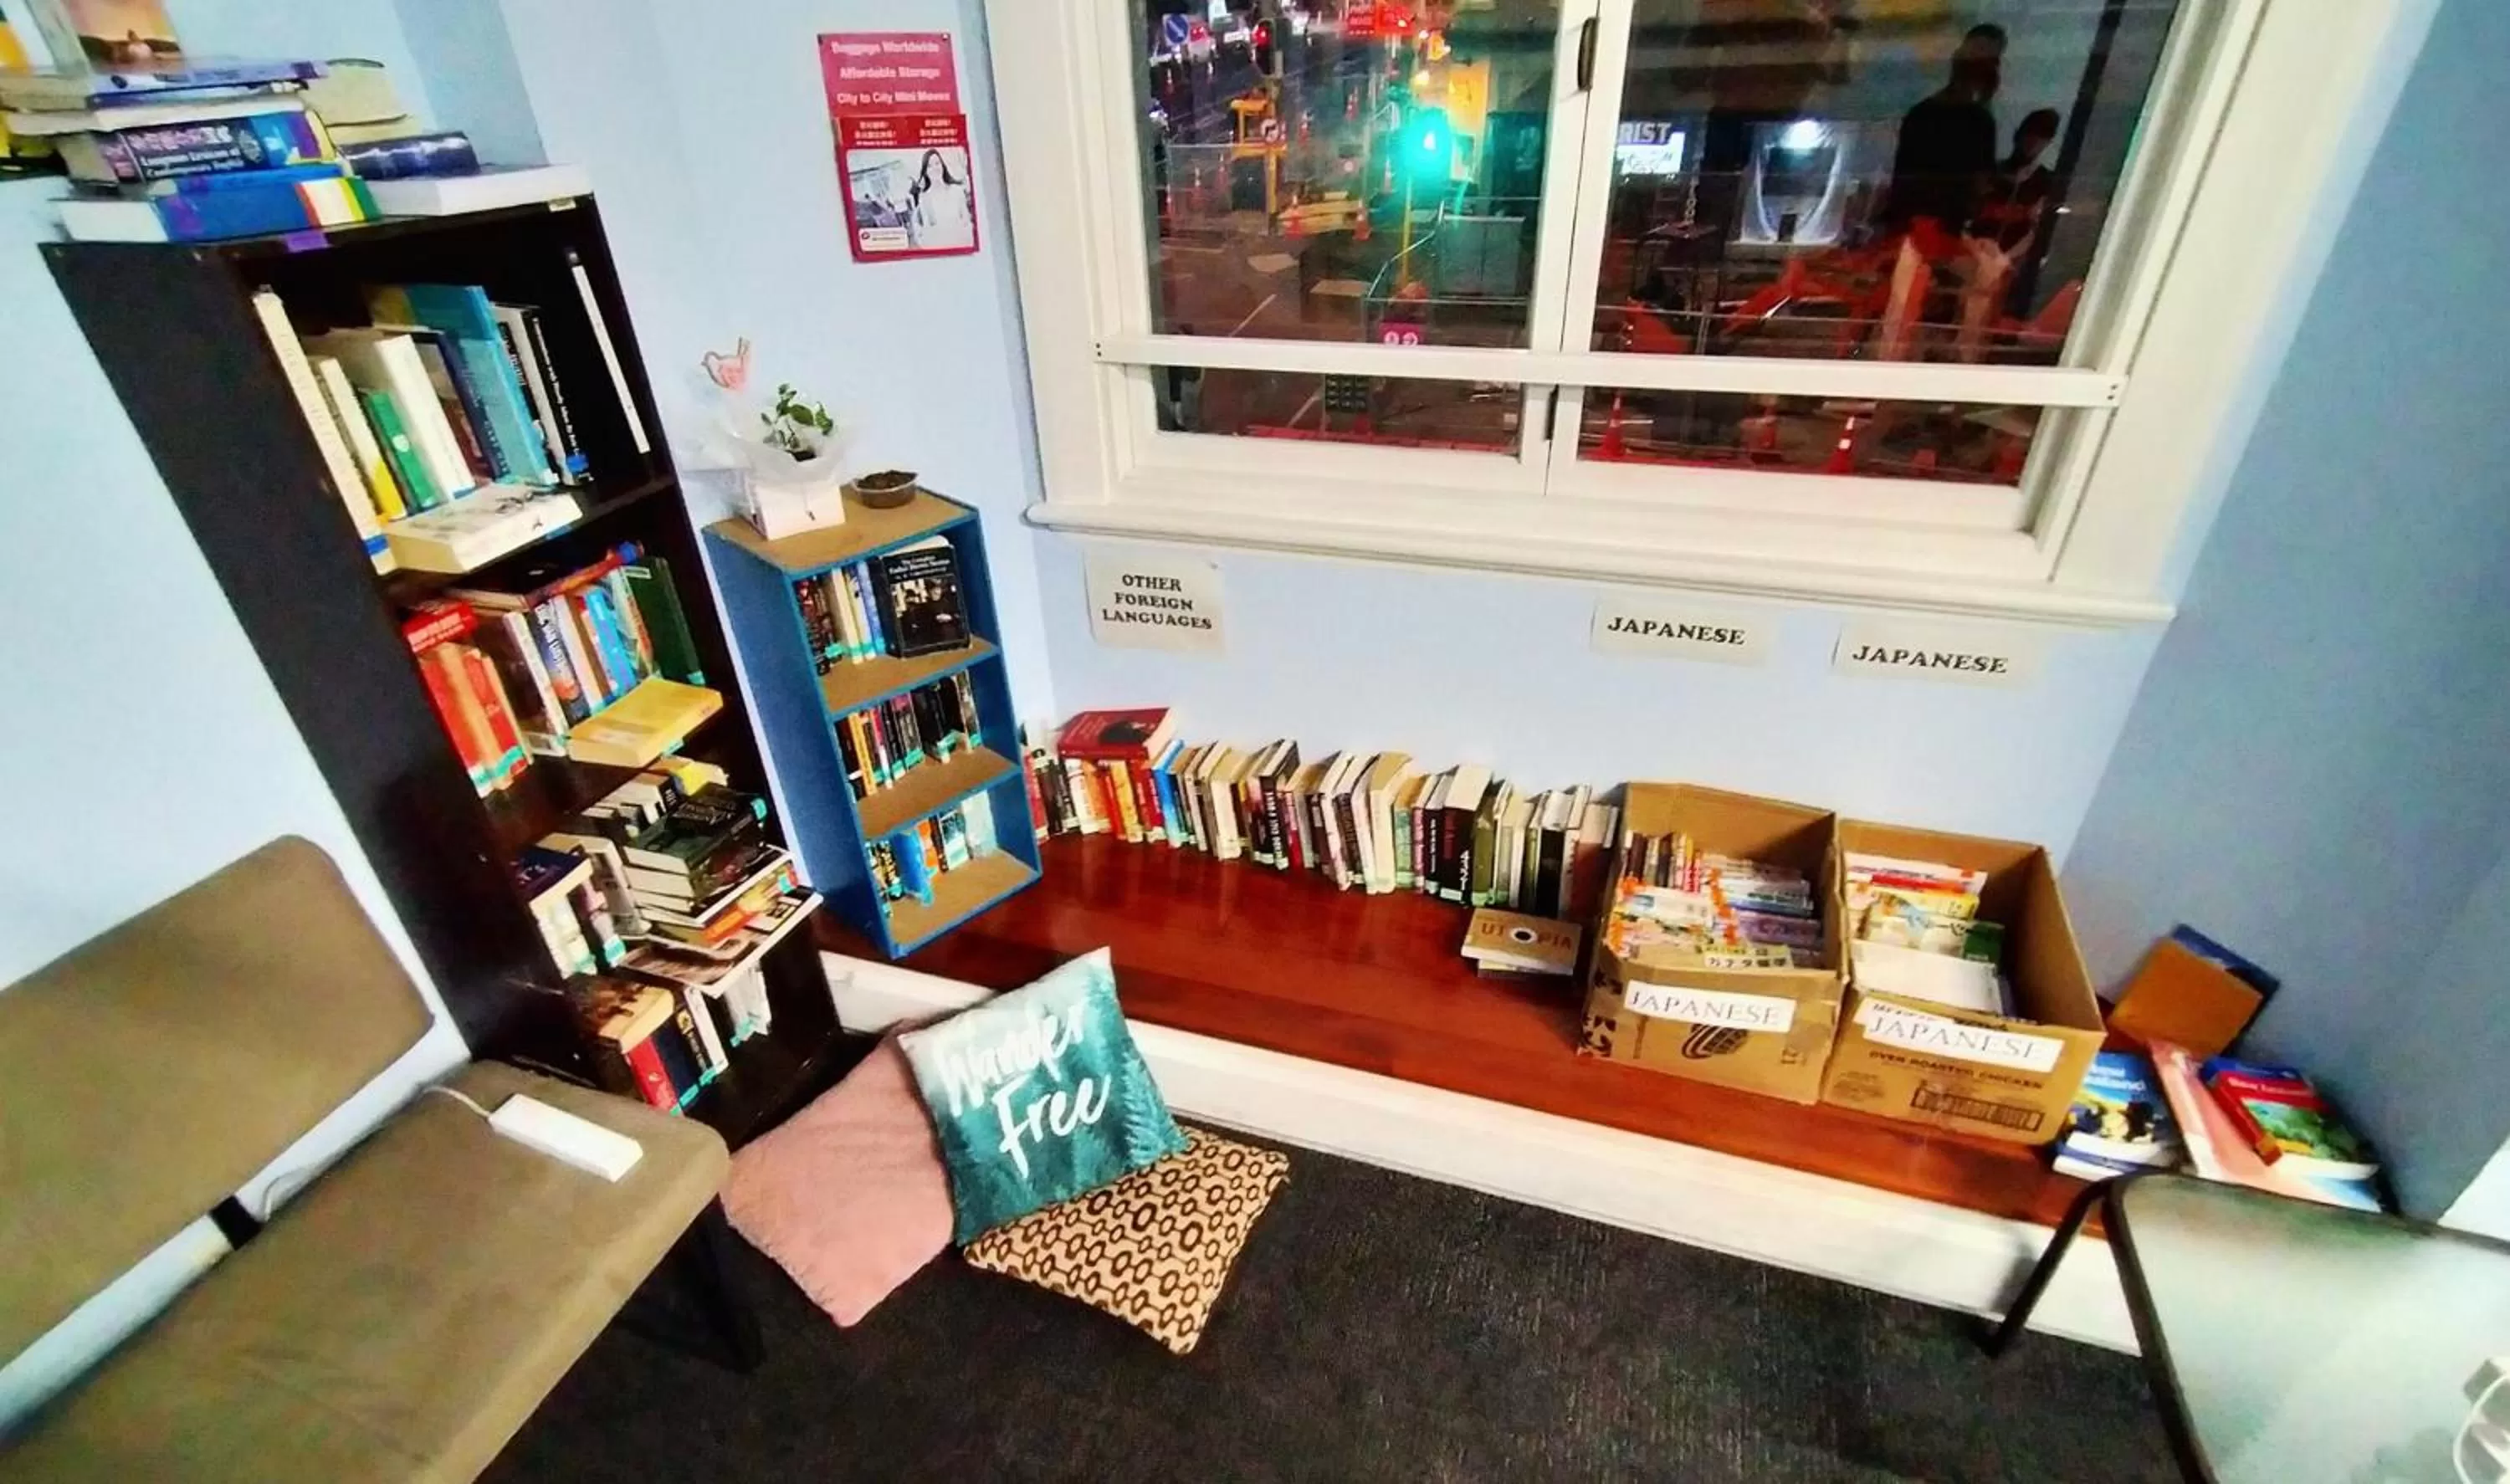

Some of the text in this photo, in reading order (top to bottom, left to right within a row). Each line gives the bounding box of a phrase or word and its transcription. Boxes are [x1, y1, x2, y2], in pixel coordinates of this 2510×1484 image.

[840, 66, 940, 79] Affordable Storage
[838, 91, 950, 106] City to City Mini Moves
[1122, 574, 1182, 592] OTHER
[1114, 591, 1193, 612] FOREIGN
[1102, 608, 1212, 630] LANGUAGES
[1608, 617, 1747, 645] JAPANESE
[1852, 646, 2009, 674] JAPANESE
[1632, 991, 1780, 1026] JAPANESE
[1868, 1016, 2044, 1059] JAPANESE
[932, 995, 1089, 1118] Wander
[991, 1072, 1113, 1179] Free
